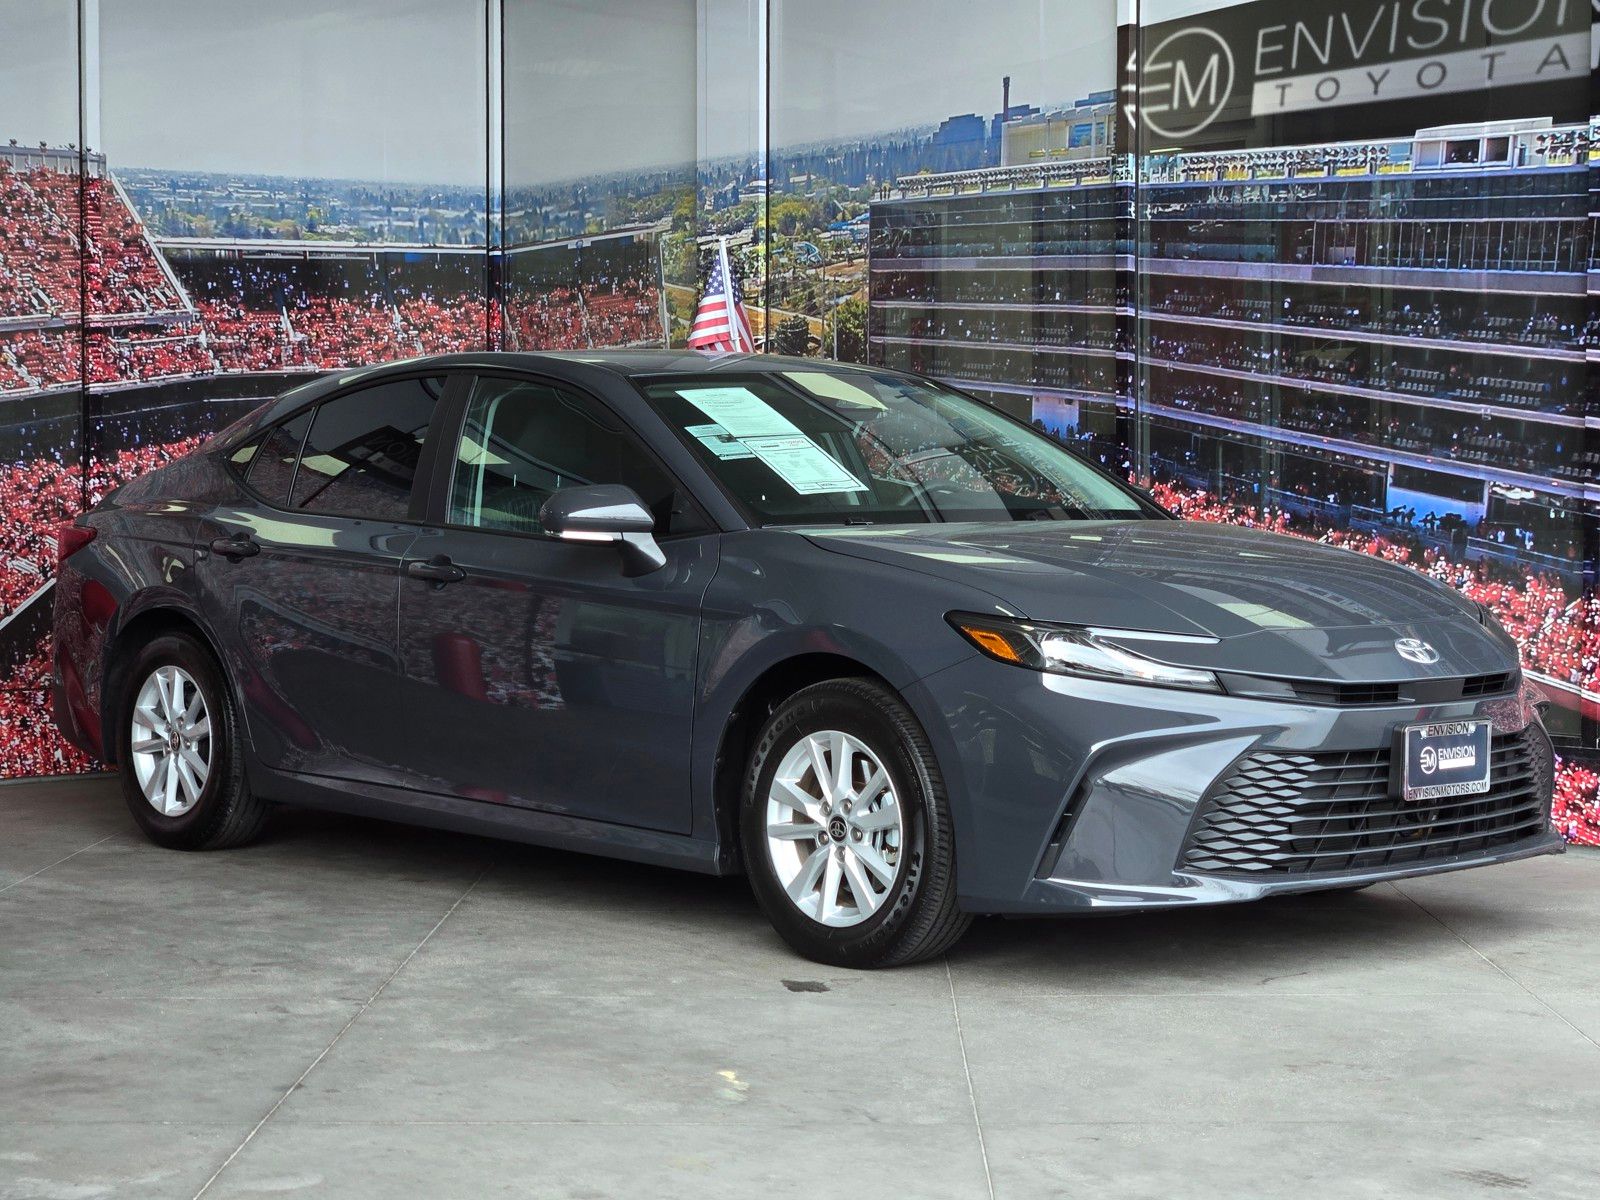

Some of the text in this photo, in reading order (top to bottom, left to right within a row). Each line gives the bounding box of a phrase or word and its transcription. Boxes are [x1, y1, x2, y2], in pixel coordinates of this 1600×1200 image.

[1275, 43, 1571, 107] TOYOTA
[1427, 722, 1470, 737] ENVISION
[1438, 745, 1476, 760] ENVISION
[1408, 781, 1487, 799] ENVISIONMOTORS.COM
